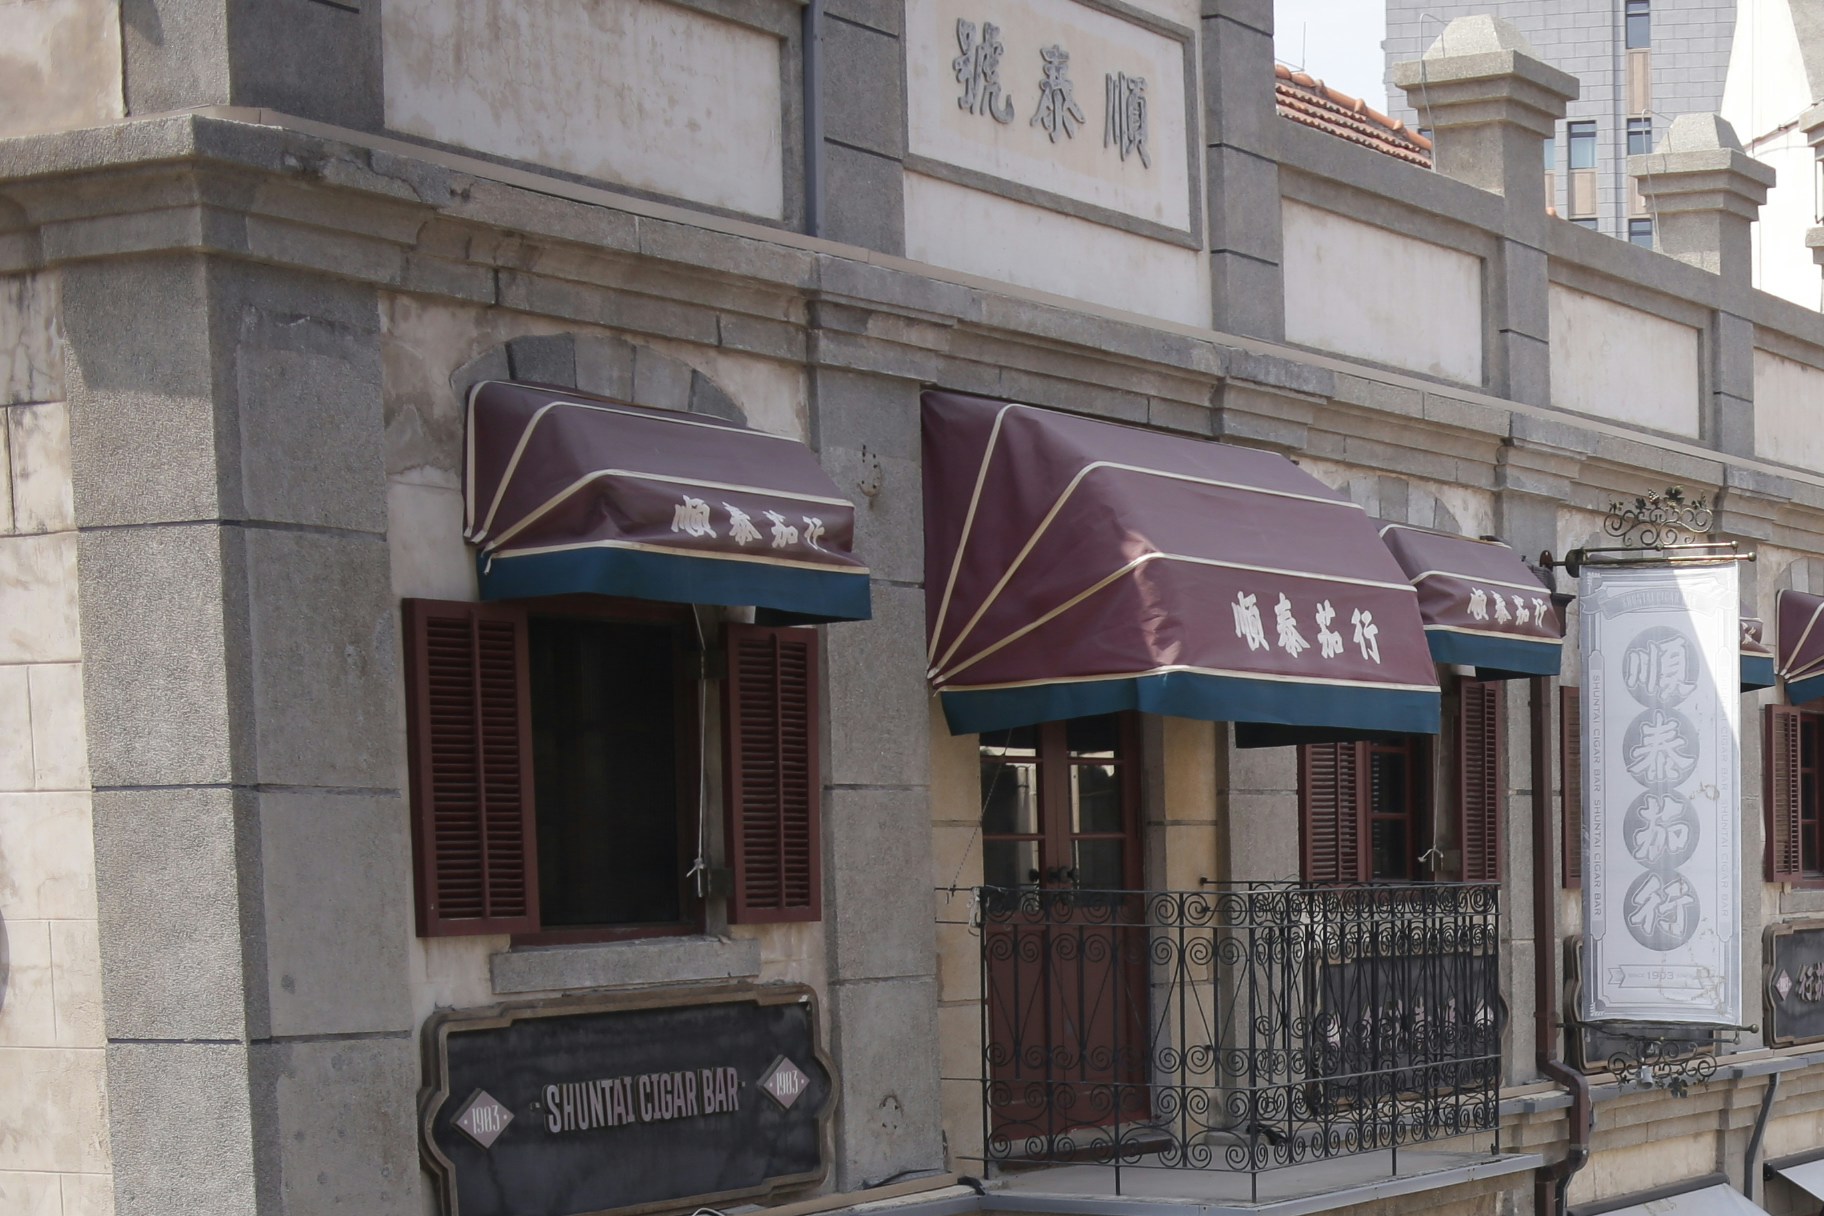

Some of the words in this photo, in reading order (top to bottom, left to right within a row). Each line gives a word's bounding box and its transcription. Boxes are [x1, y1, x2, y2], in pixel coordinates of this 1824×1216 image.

[1592, 674, 1601, 724] SHUNTAI
[1592, 728, 1601, 765] CIGAR
[1592, 769, 1601, 792] BAR
[1593, 799, 1601, 850] SHUNTAI
[1593, 854, 1601, 887] CIGAR
[1593, 892, 1601, 917] BAR
[1647, 970, 1674, 980] 1903
[776, 1071, 800, 1096] 1903
[545, 1077, 634, 1133] SHUNTAI
[637, 1070, 698, 1122] CIGAR
[701, 1066, 739, 1114] BAR
[472, 1106, 500, 1134] 1903
